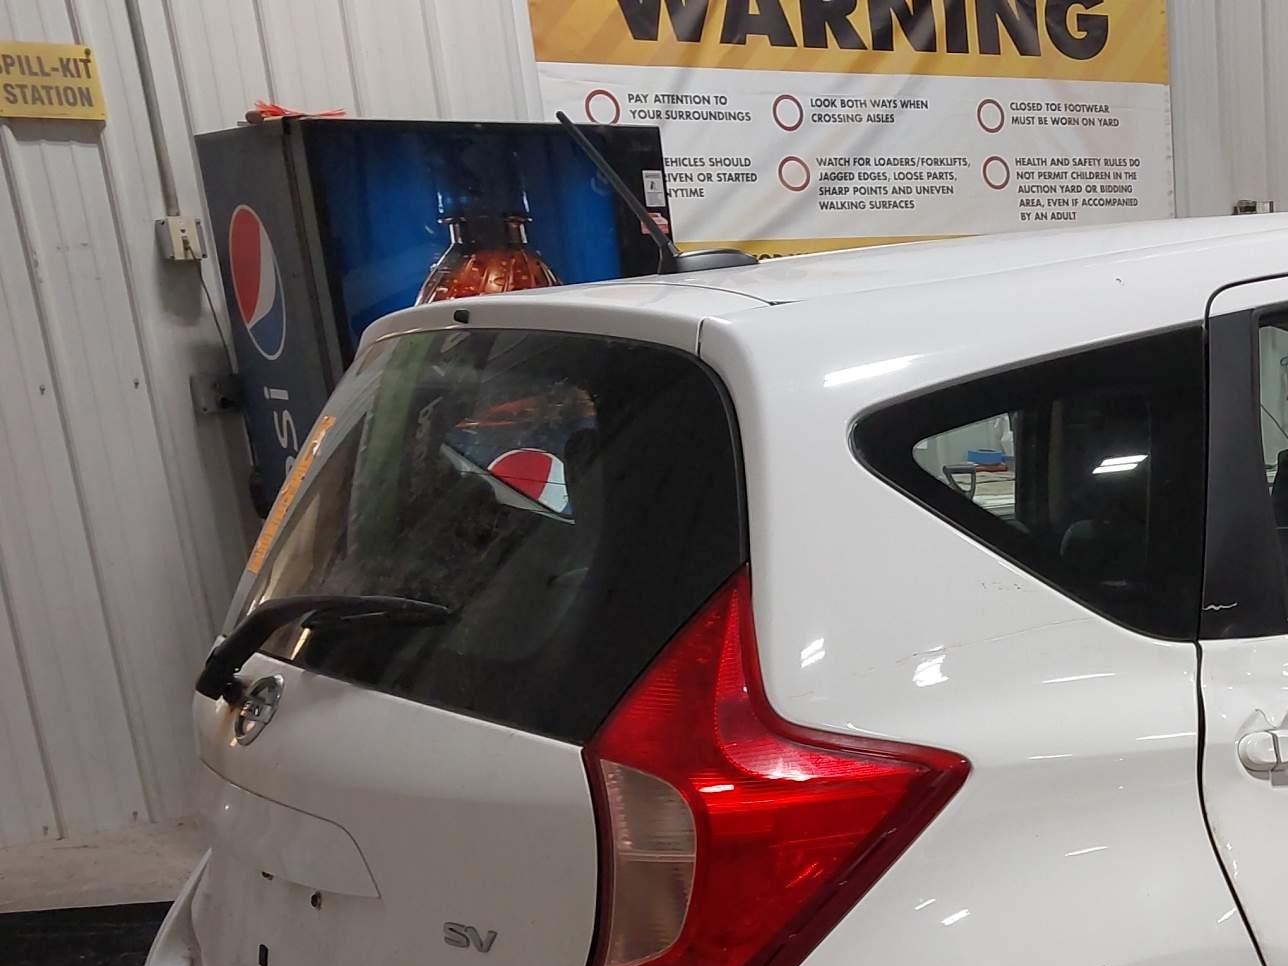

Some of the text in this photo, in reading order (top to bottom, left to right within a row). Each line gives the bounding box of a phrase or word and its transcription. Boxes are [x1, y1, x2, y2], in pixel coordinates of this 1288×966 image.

[616, 0, 1109, 60] WARNING
[0, 53, 92, 79] PILL-KIT
[3, 83, 94, 107] STATION
[627, 93, 728, 106] PAY ATTENTION TO
[810, 98, 928, 110] LOOK BOTH WAYS WHEN
[1009, 102, 1110, 113] CLOSED TOE FOOTWEAR
[630, 109, 752, 122] YOUR SURROUNDINGS
[811, 113, 895, 123] CROSSING AISLES
[1011, 116, 1120, 127] MUST BE WORN ON YARD
[663, 157, 752, 168] EHICLES SHOULD
[816, 157, 971, 168] WATCH FOR LOADERS/FORKLIFTS,
[1015, 157, 1140, 167] HEALTH AND SAFETY RULES DO
[666, 172, 758, 183] IVEN OR STARTED
[818, 171, 957, 182] JAGGED EDGES, LOOSE PARTS,
[1016, 171, 1137, 180] NOT PERMIT CHILDREN IN THE
[667, 187, 705, 198] NYTIME
[819, 185, 954, 196] SHARP POINTS AND UNEVEN
[1018, 185, 1132, 194] AUCTION YARD OR BIDDING
[819, 200, 915, 210] WALKING SURFACES
[1019, 198, 1138, 208] AREA, EVEN IF ACCOMPANIED
[1021, 212, 1077, 221] BY AN ADULT
[443, 921, 498, 953] SV
